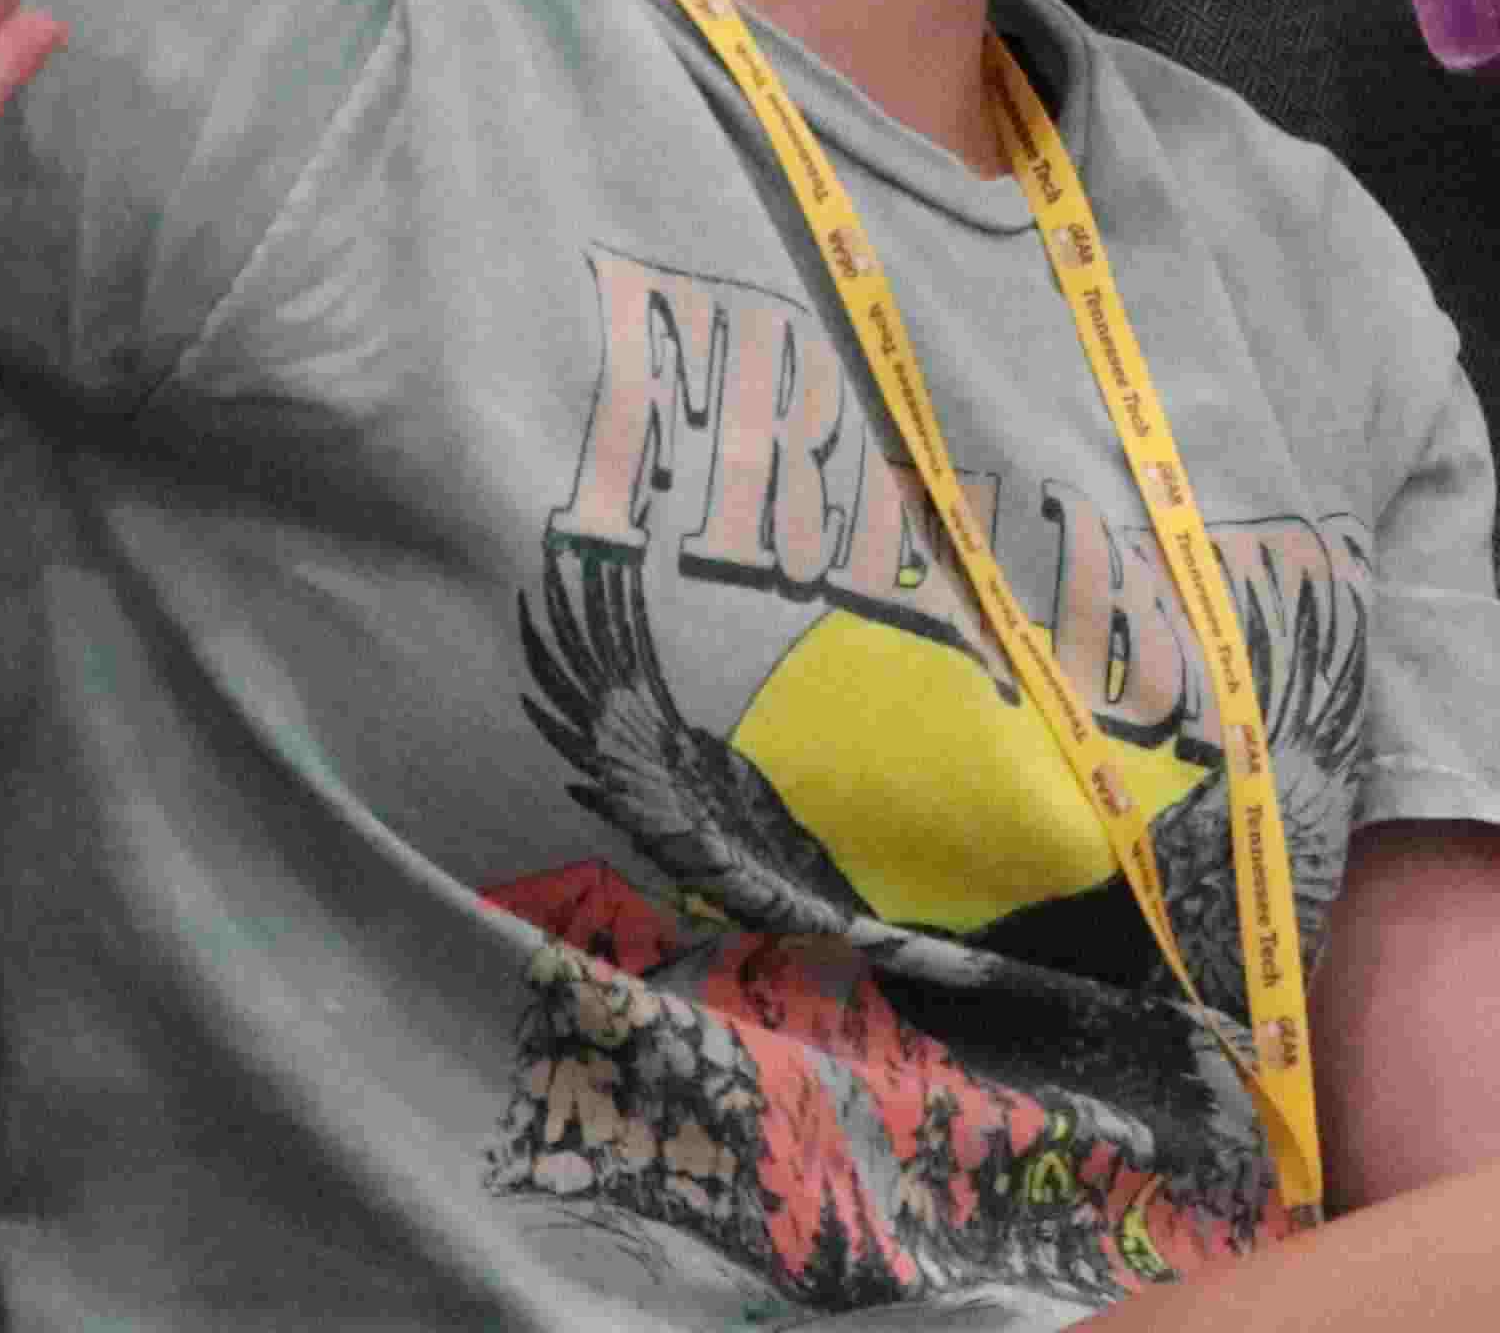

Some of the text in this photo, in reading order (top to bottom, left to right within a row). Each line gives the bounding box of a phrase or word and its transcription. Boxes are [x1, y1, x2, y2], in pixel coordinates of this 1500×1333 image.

[1083, 285, 1151, 438] Tennessee Tech
[1175, 529, 1241, 695] Tennessee Tech
[1245, 804, 1282, 989] Tennessee Tech
